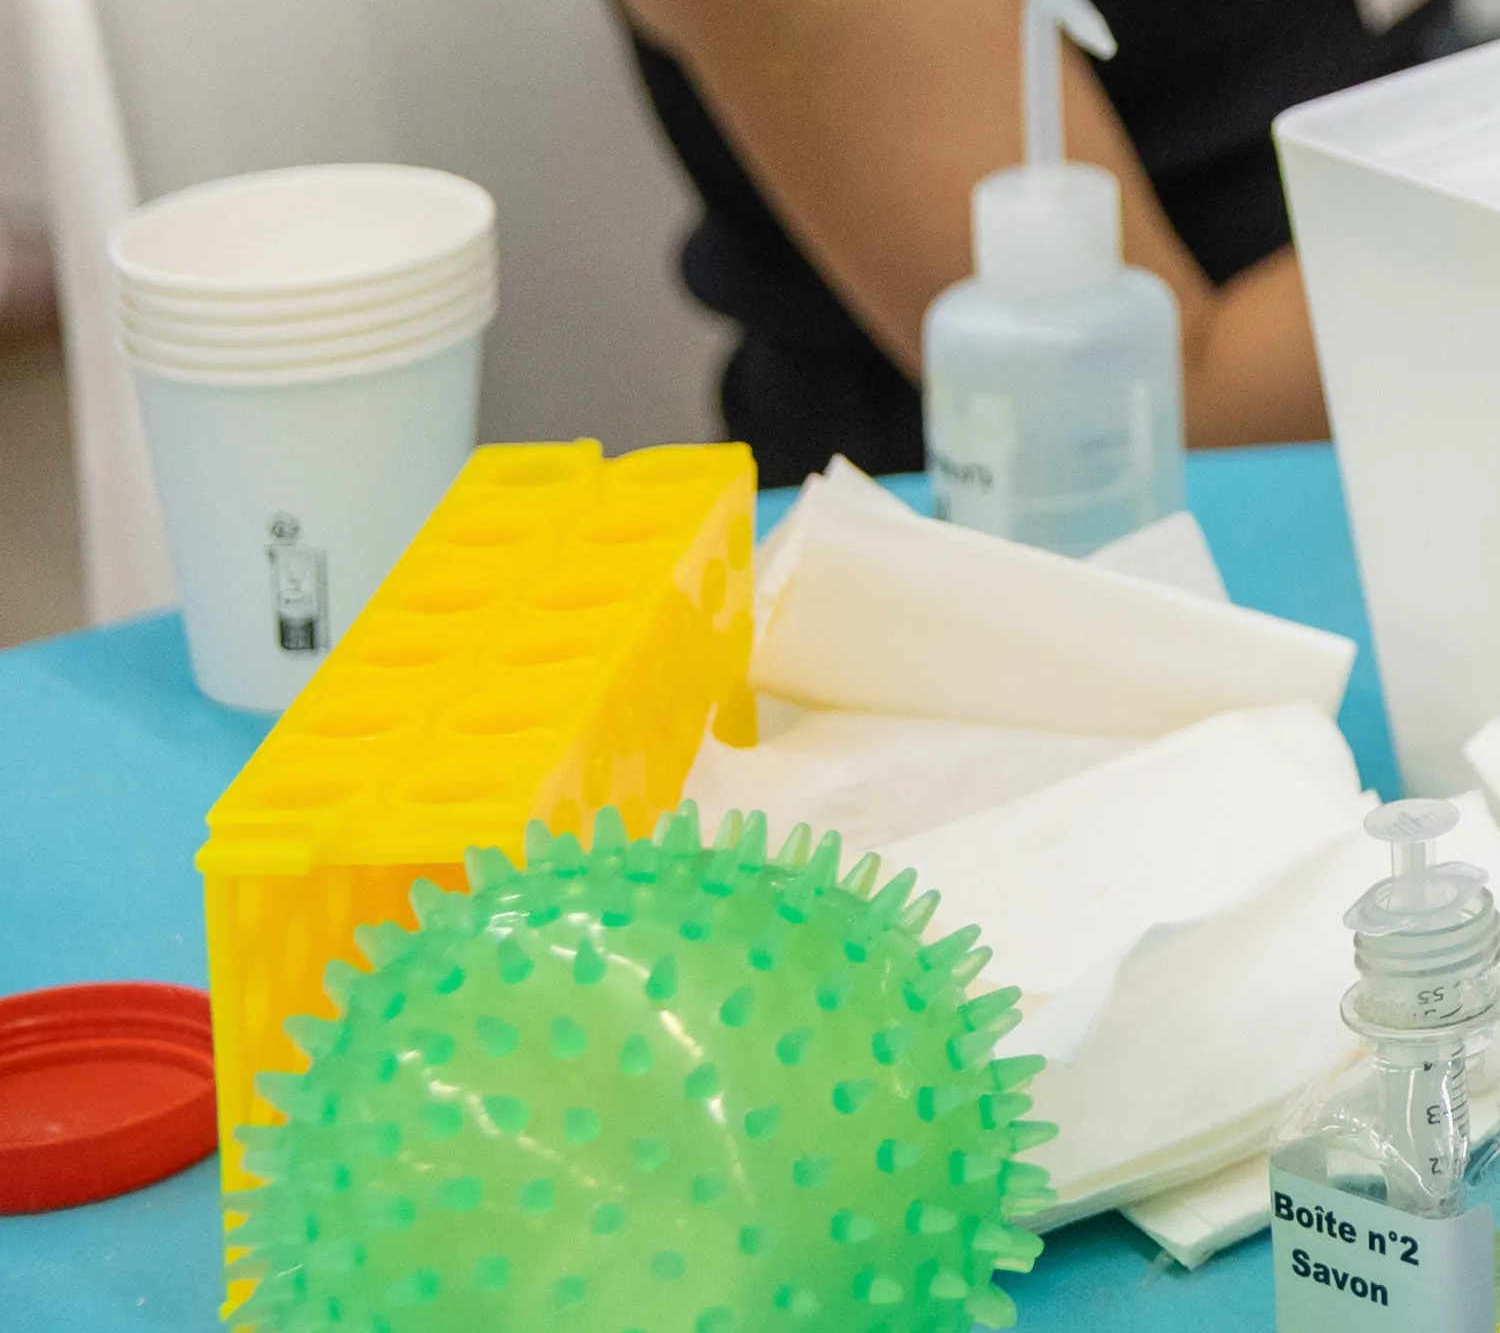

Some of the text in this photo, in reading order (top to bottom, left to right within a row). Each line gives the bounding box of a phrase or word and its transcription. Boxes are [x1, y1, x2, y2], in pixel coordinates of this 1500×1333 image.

[1274, 1190, 1420, 1267] Boîte n°2
[1291, 1248, 1389, 1307] Savon
